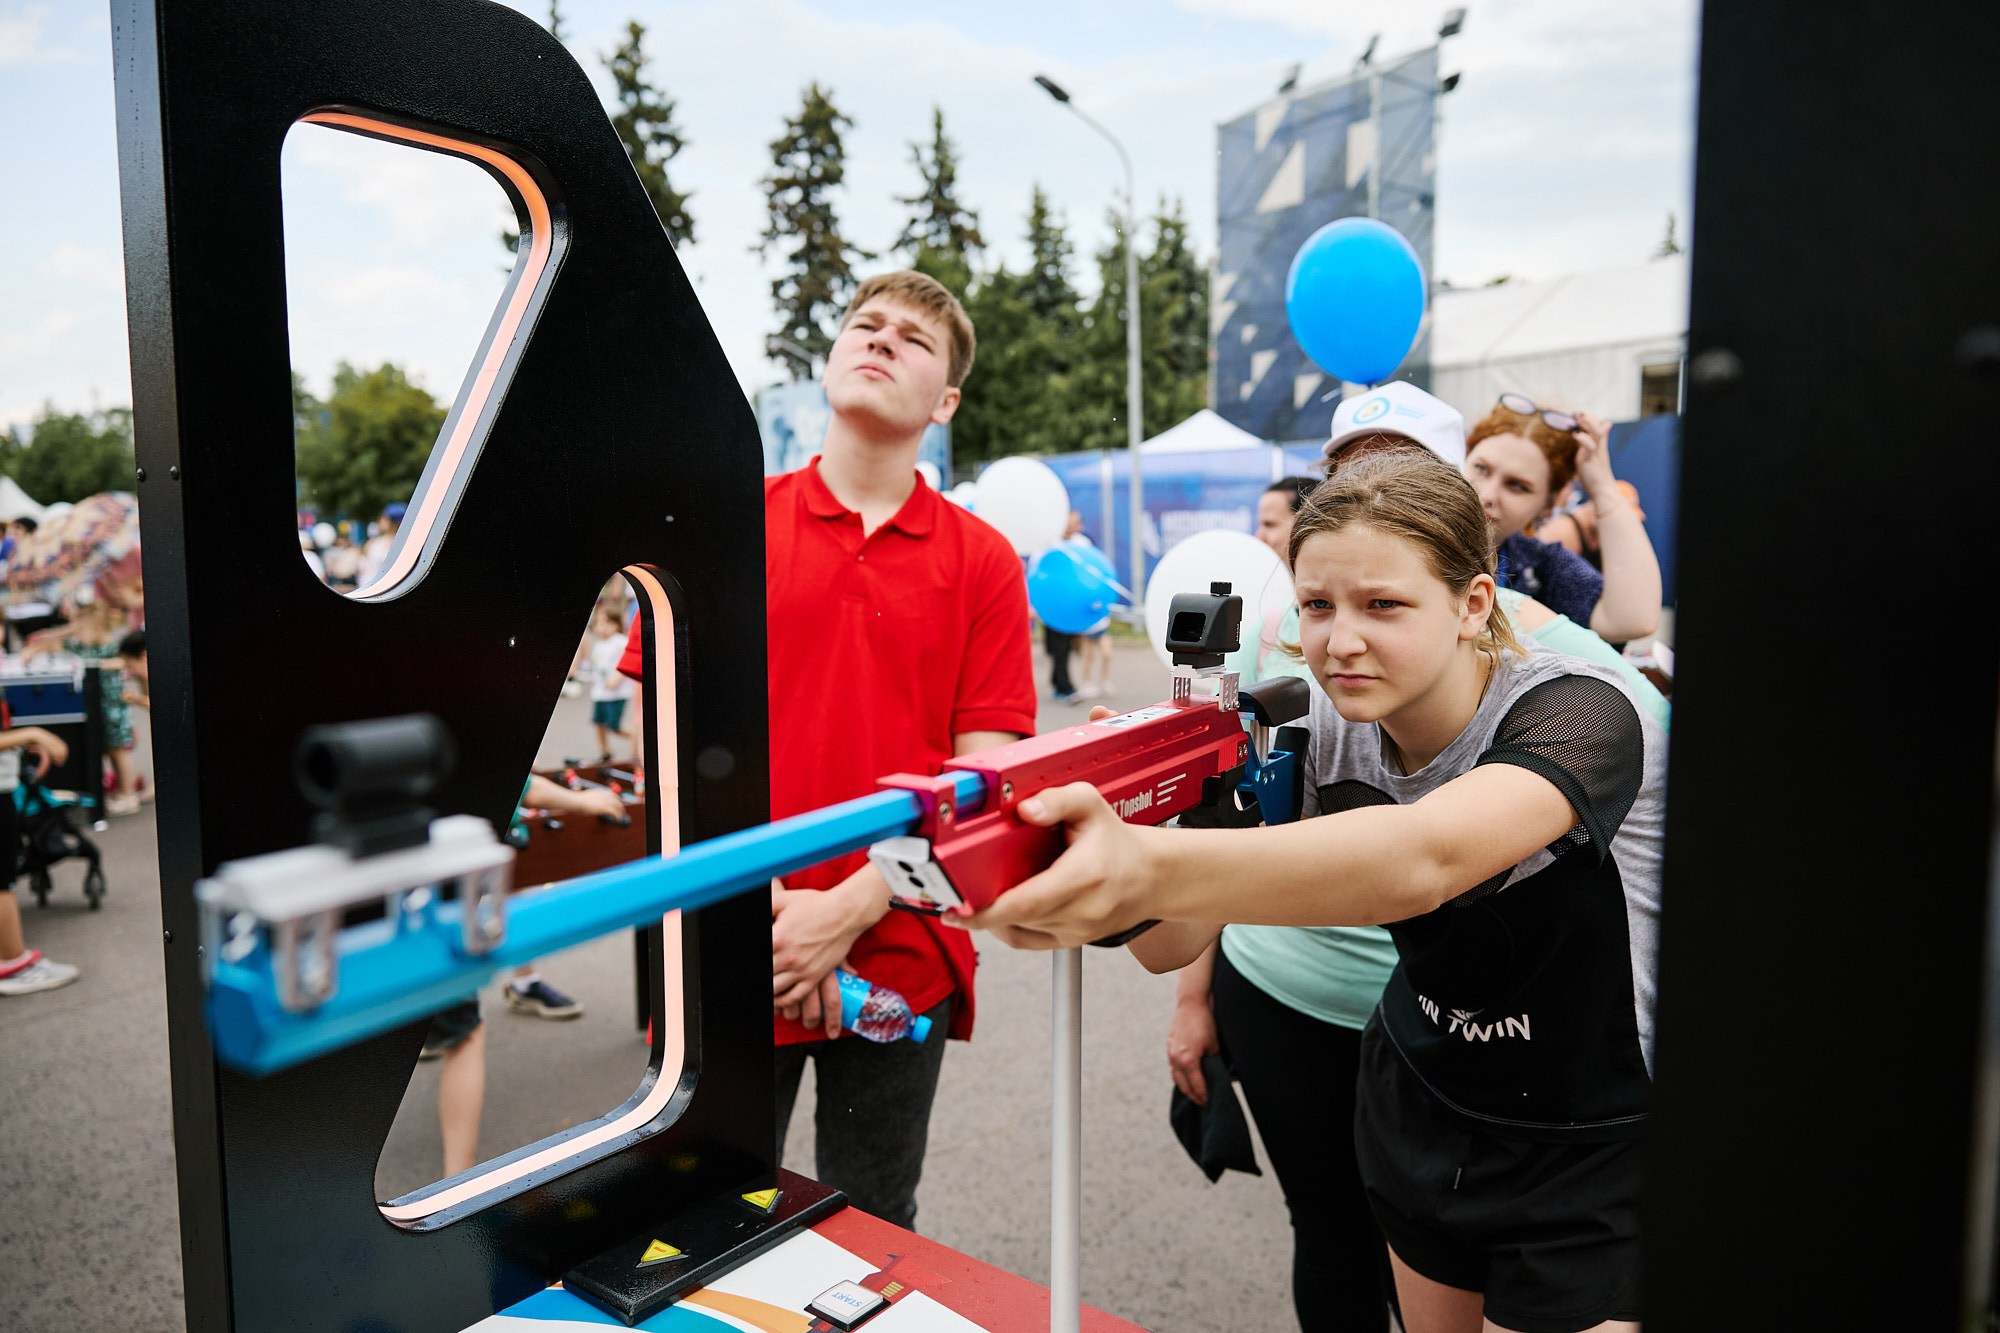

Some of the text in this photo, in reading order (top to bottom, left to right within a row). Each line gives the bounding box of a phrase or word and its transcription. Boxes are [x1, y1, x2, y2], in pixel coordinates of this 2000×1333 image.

[1119, 788, 1153, 819] Topshot
[1418, 994, 1531, 1042] IN TWIN
[831, 1291, 863, 1309] START
